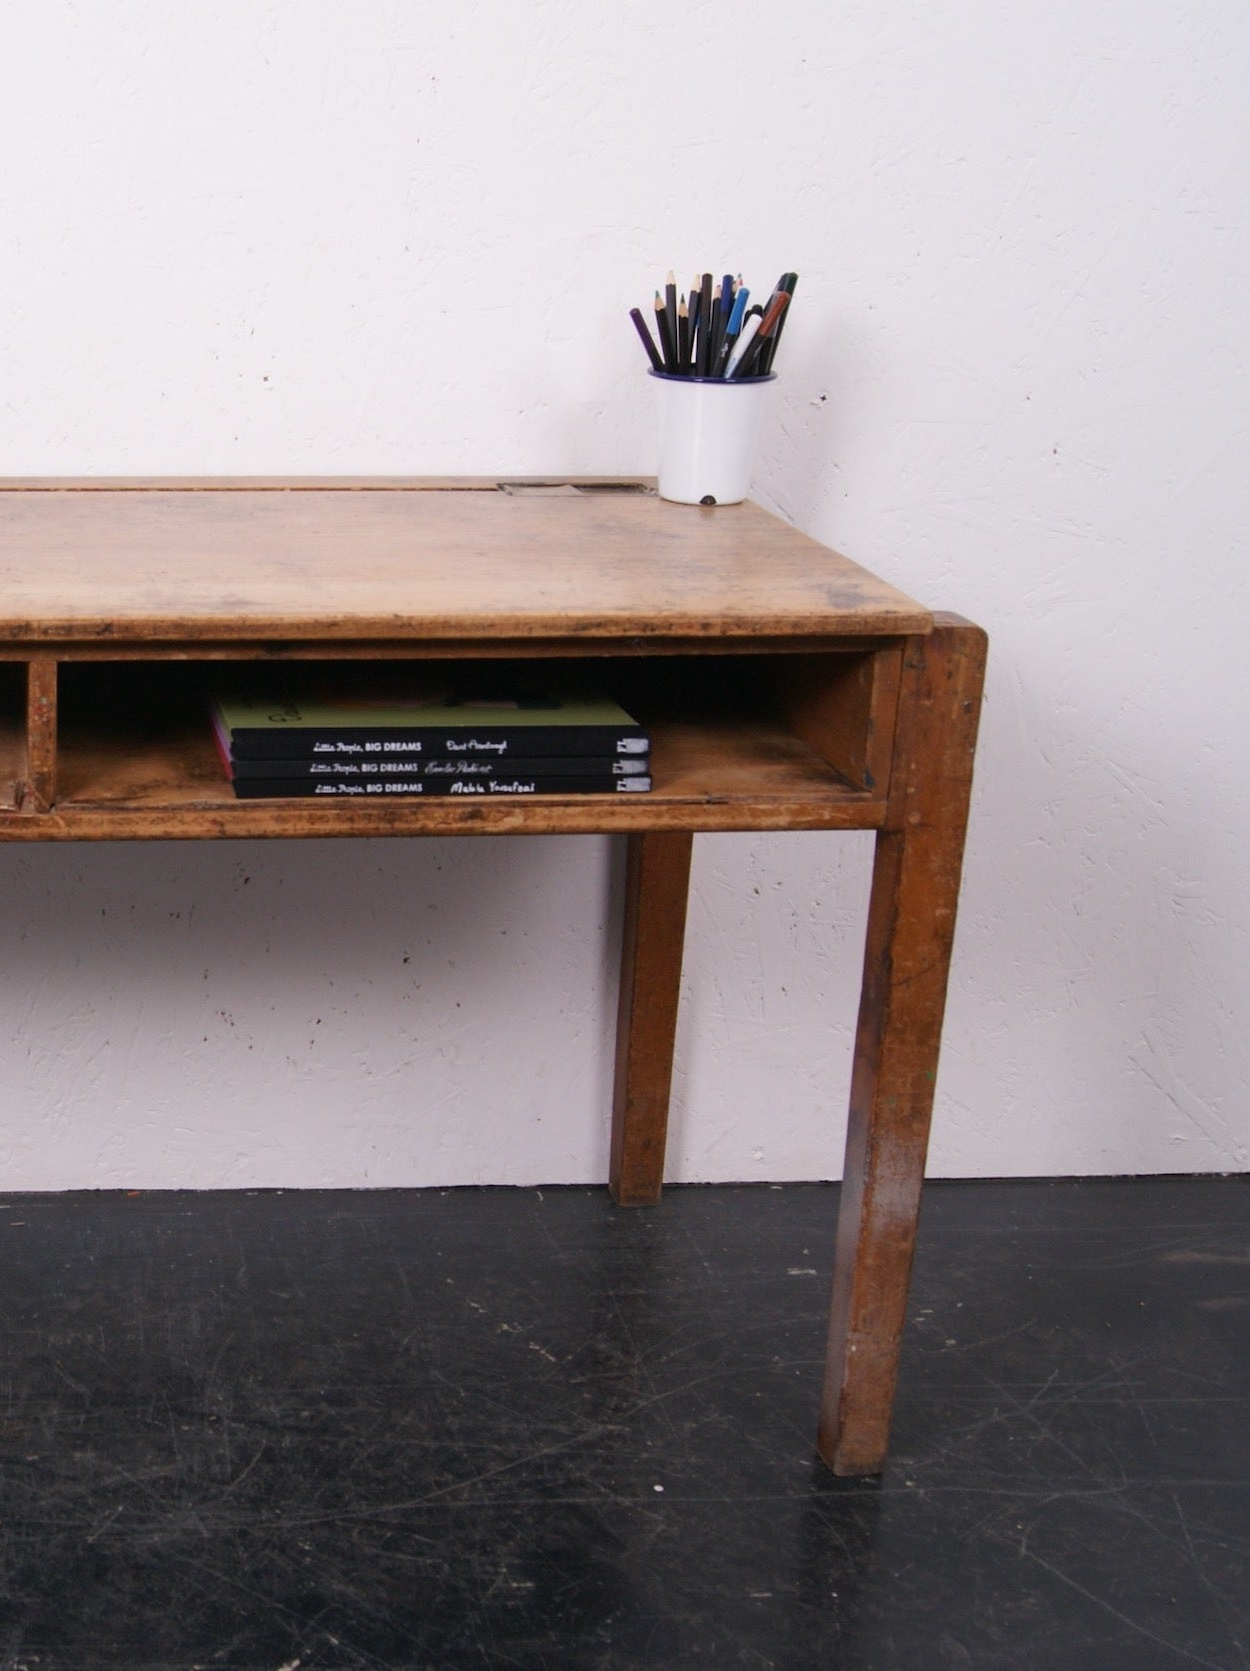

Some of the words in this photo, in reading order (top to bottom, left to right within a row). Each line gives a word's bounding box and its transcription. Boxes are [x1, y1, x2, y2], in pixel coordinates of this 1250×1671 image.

[365, 742, 382, 752] BIG
[383, 742, 421, 752] DREAMS
[361, 763, 378, 772] BIG
[380, 763, 418, 772] DREAMS
[366, 784, 383, 793] BIG
[385, 783, 423, 792] DREAMS
